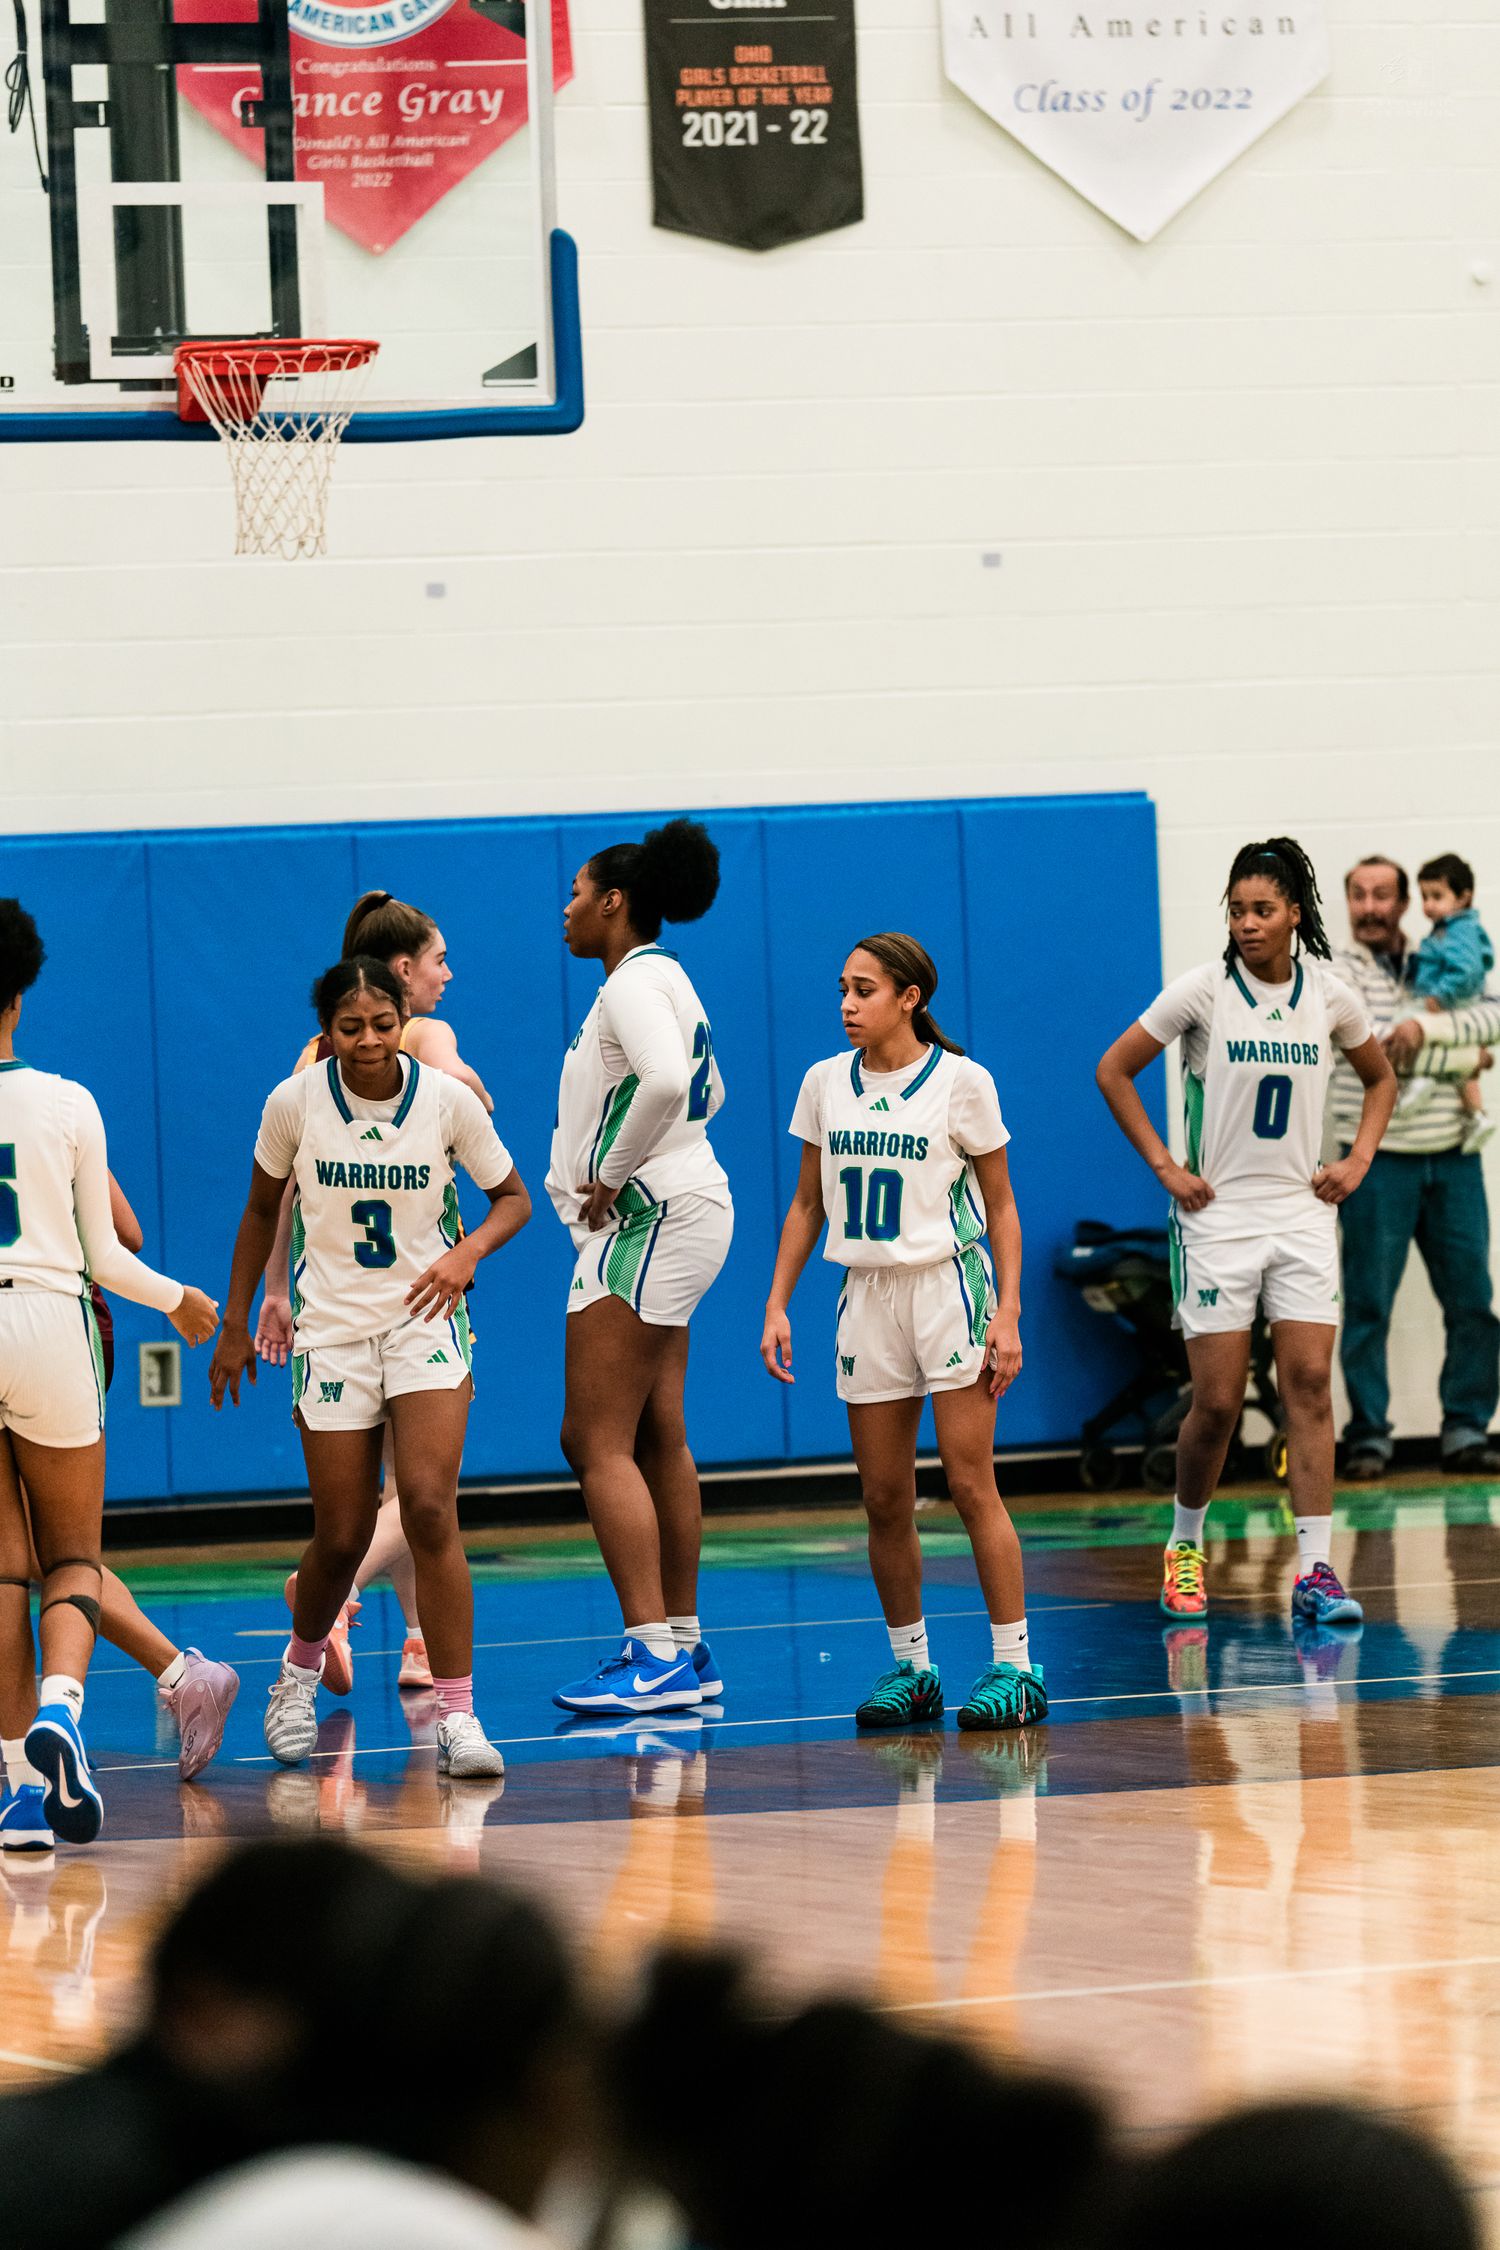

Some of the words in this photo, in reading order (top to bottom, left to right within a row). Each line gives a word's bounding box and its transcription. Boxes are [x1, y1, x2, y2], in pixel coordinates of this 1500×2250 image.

[288, 4, 395, 34] AMERICAN
[969, 13, 1036, 38] All
[1071, 11, 1296, 38] American
[295, 56, 438, 79] Congratulations
[680, 68, 726, 86] GIRLS
[728, 65, 828, 84] BASKETBALL
[231, 86, 383, 119] Cance
[398, 83, 504, 125] Gray
[675, 88, 735, 107] PLAYER
[737, 87, 757, 106] OF
[761, 86, 792, 105] THE
[793, 86, 833, 105] YEAR
[1013, 80, 1107, 113] Class
[1121, 78, 1163, 122] of
[1170, 87, 1253, 111] 2022
[294, 133, 362, 150] Donald's
[682, 110, 759, 147] 2021
[789, 109, 829, 145] 22
[1226, 1040, 1319, 1066] WARRIORS
[1252, 1074, 1293, 1140] 0
[828, 1130, 929, 1161] WARRIORS
[315, 1159, 430, 1190] WARRIORS
[839, 1166, 904, 1242] 10
[351, 1200, 397, 1269] 3
